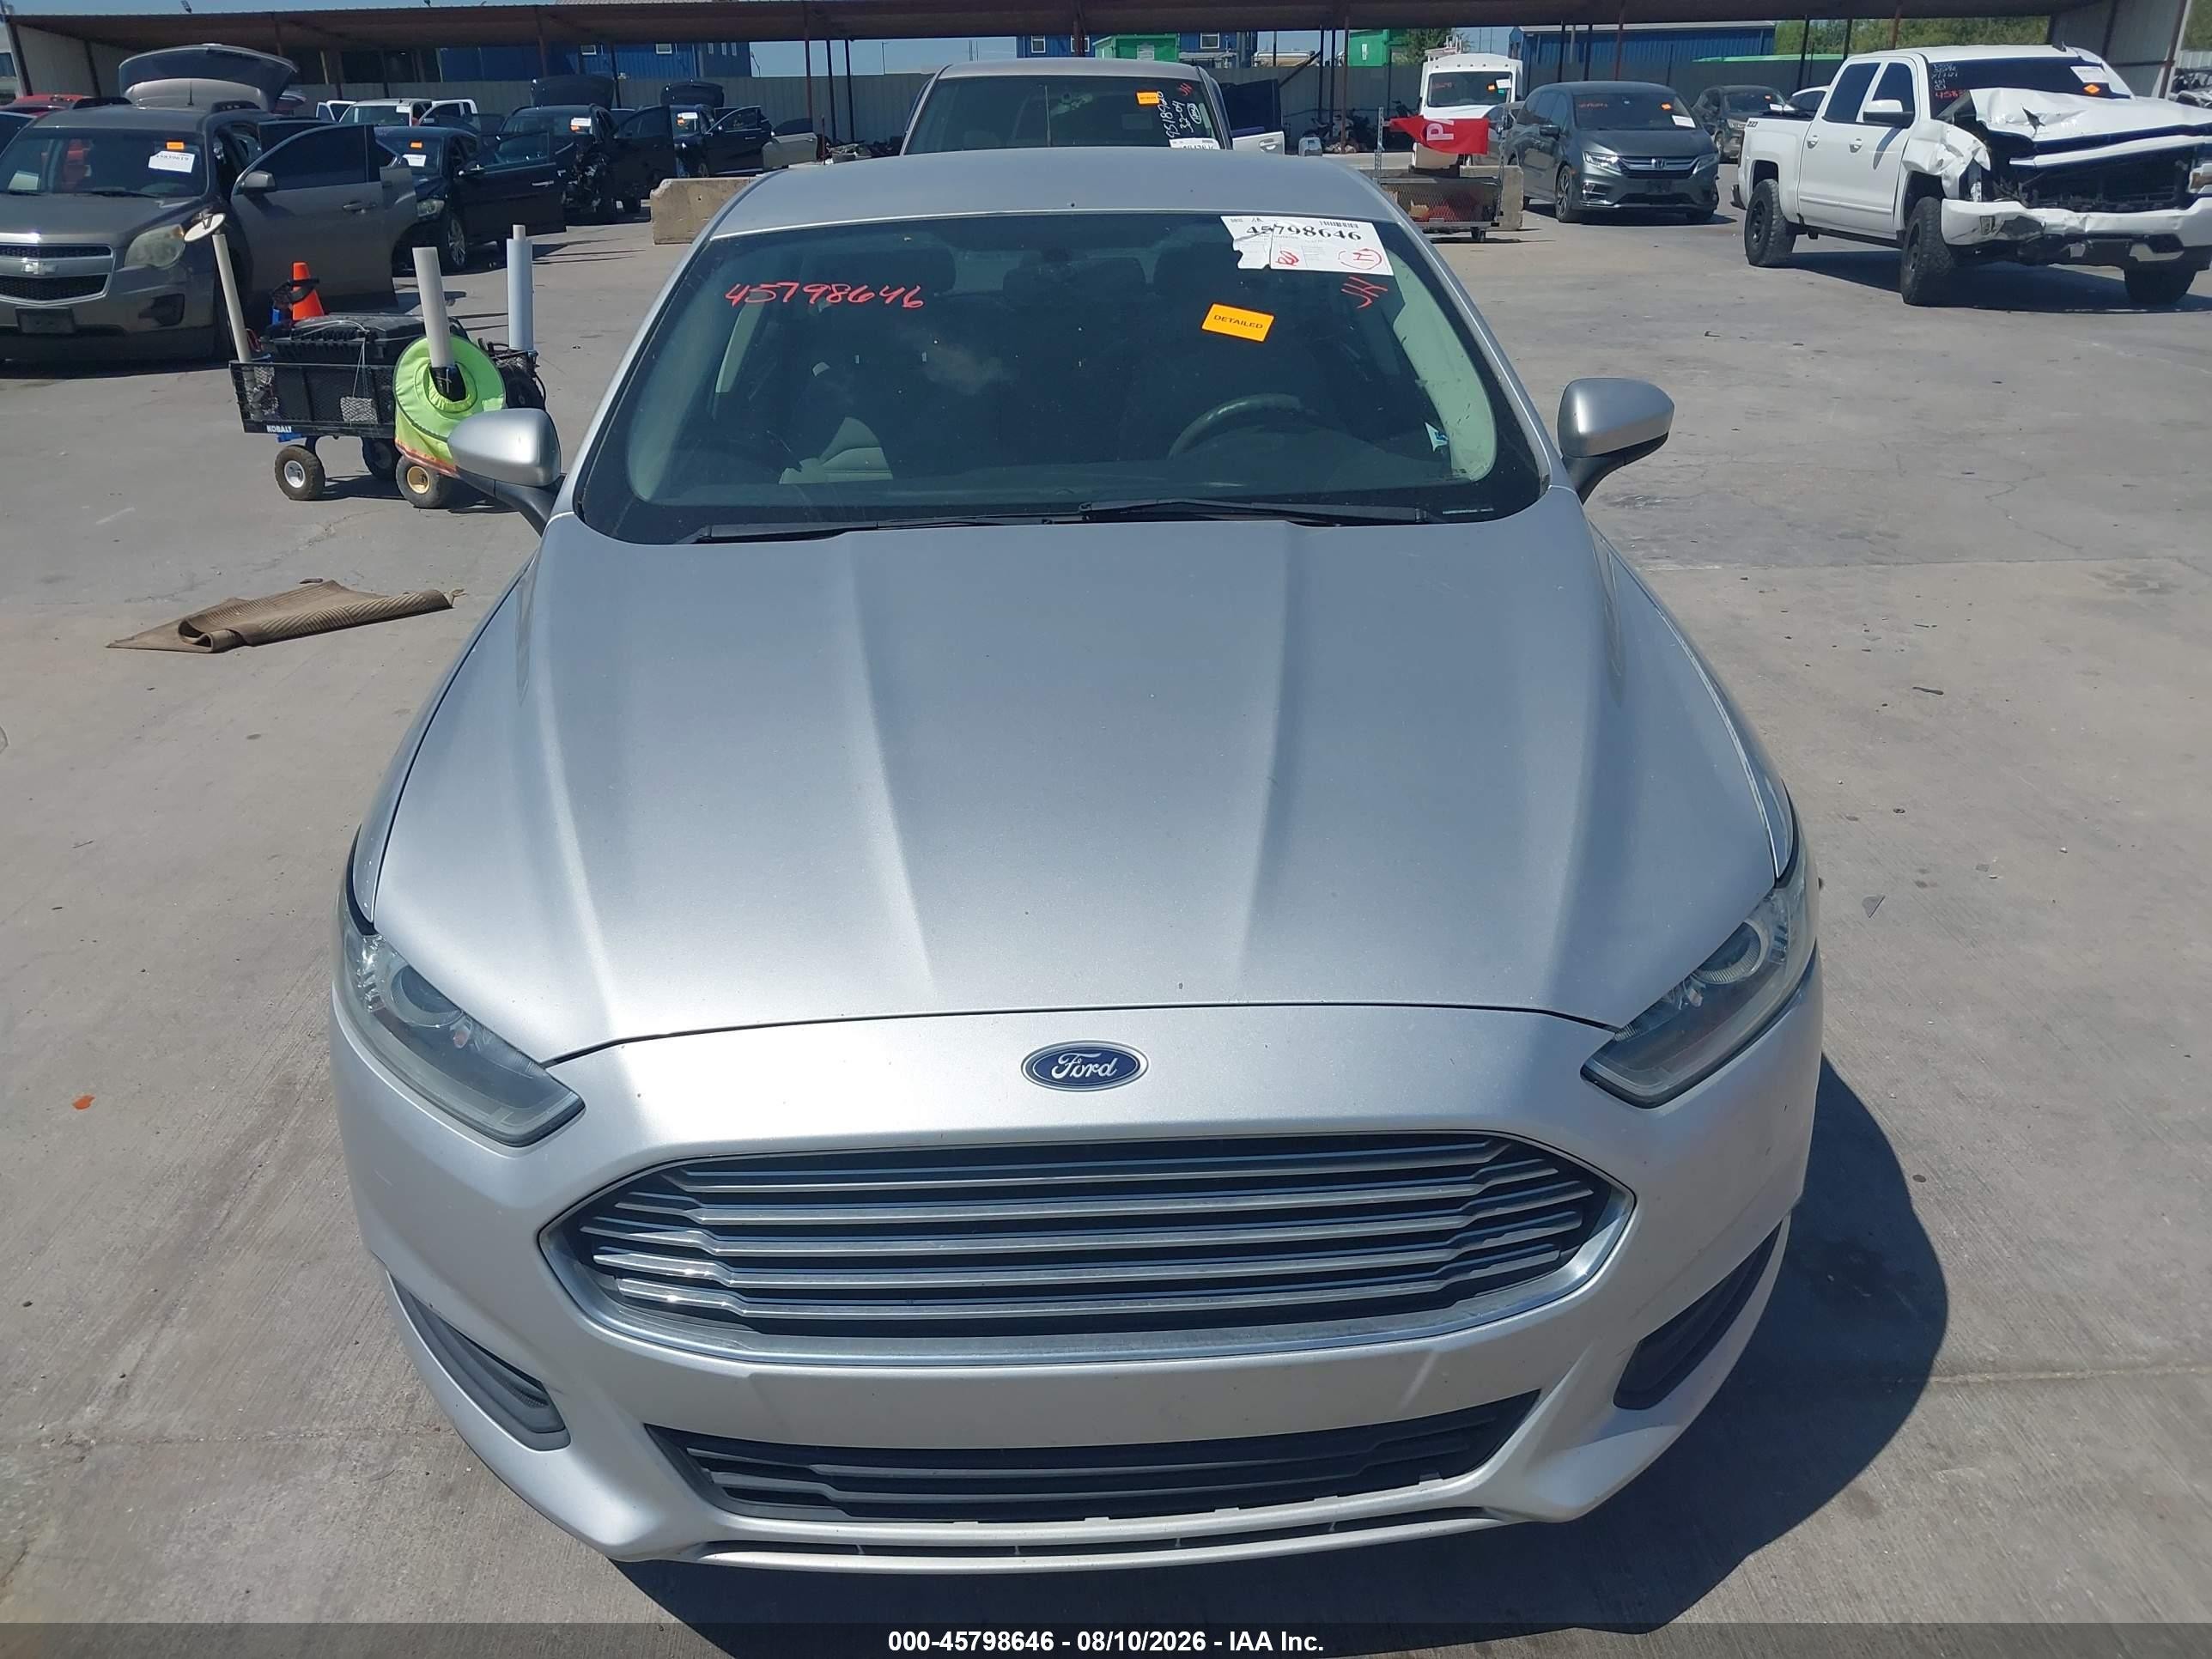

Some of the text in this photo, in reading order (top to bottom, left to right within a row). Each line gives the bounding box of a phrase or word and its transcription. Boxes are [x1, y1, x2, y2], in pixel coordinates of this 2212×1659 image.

[1246, 223, 1362, 241] 45798646
[726, 282, 924, 308] 45798646
[1213, 314, 1263, 329] DETAILED
[266, 424, 292, 434] KOBALT
[1051, 1052, 1119, 1079] Ford
